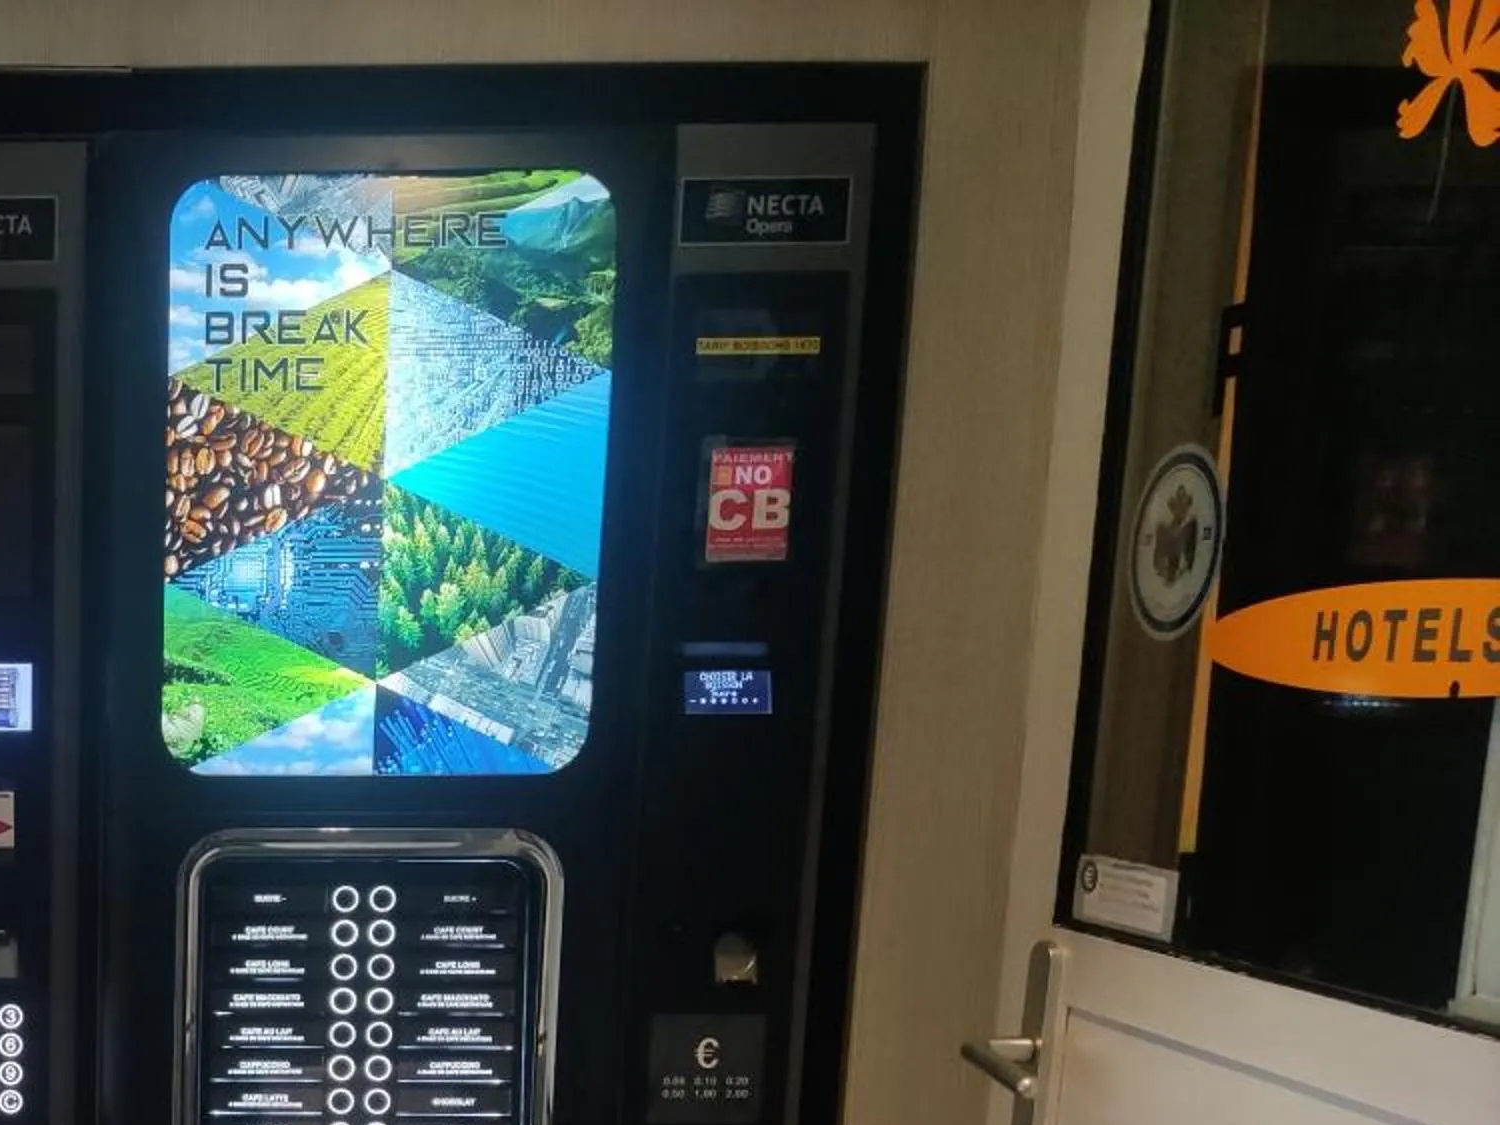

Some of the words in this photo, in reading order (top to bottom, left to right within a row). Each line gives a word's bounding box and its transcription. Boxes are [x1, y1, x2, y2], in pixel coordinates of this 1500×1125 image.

[747, 194, 825, 216] NECTA
[205, 211, 508, 251] ANYWHERE
[746, 217, 794, 237] Opera
[204, 263, 250, 298] IS
[204, 309, 369, 346] BREAK
[204, 357, 326, 393] TIME
[735, 465, 773, 485] NO
[708, 488, 791, 531] CB
[1311, 606, 1500, 664] HOTELS
[5, 1010, 16, 1023] 3
[694, 1037, 720, 1069] €
[5, 1066, 17, 1080] 9
[4, 1095, 17, 1109] C
